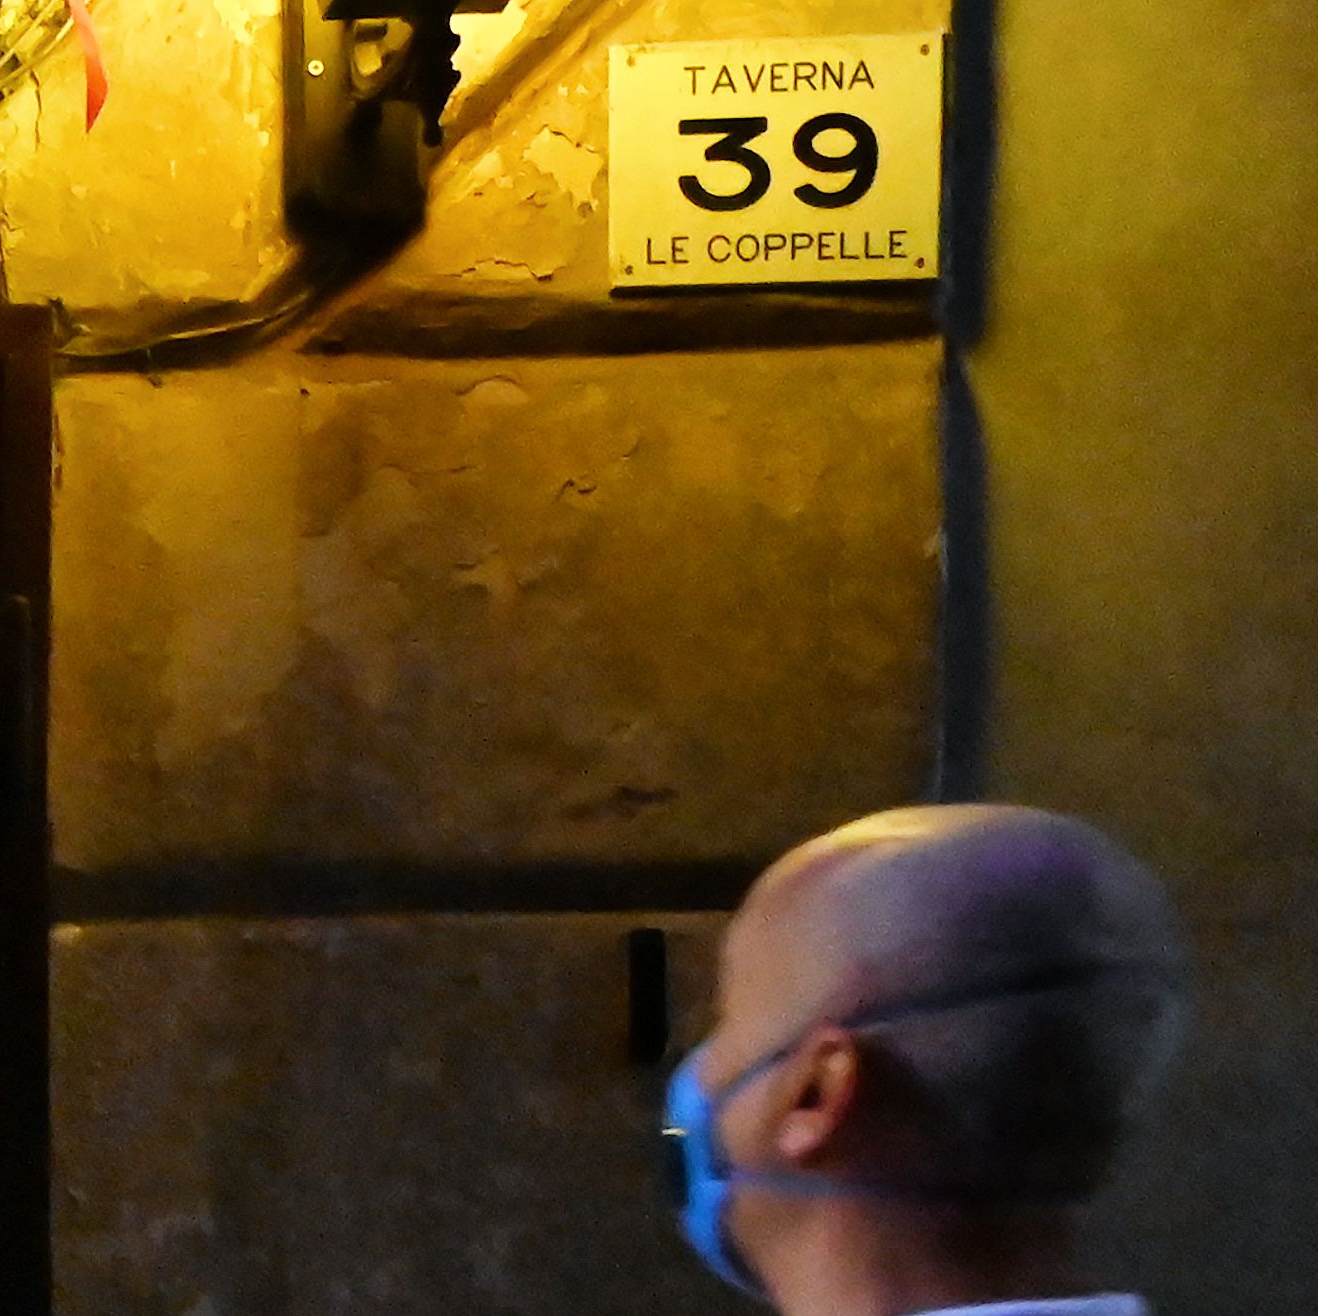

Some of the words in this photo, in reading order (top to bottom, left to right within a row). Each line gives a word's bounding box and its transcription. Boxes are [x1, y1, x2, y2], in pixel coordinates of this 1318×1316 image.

[684, 60, 876, 96] TAVERNA
[677, 112, 880, 212] 39
[646, 236, 690, 265] LE
[706, 230, 909, 263] COPPELLE
